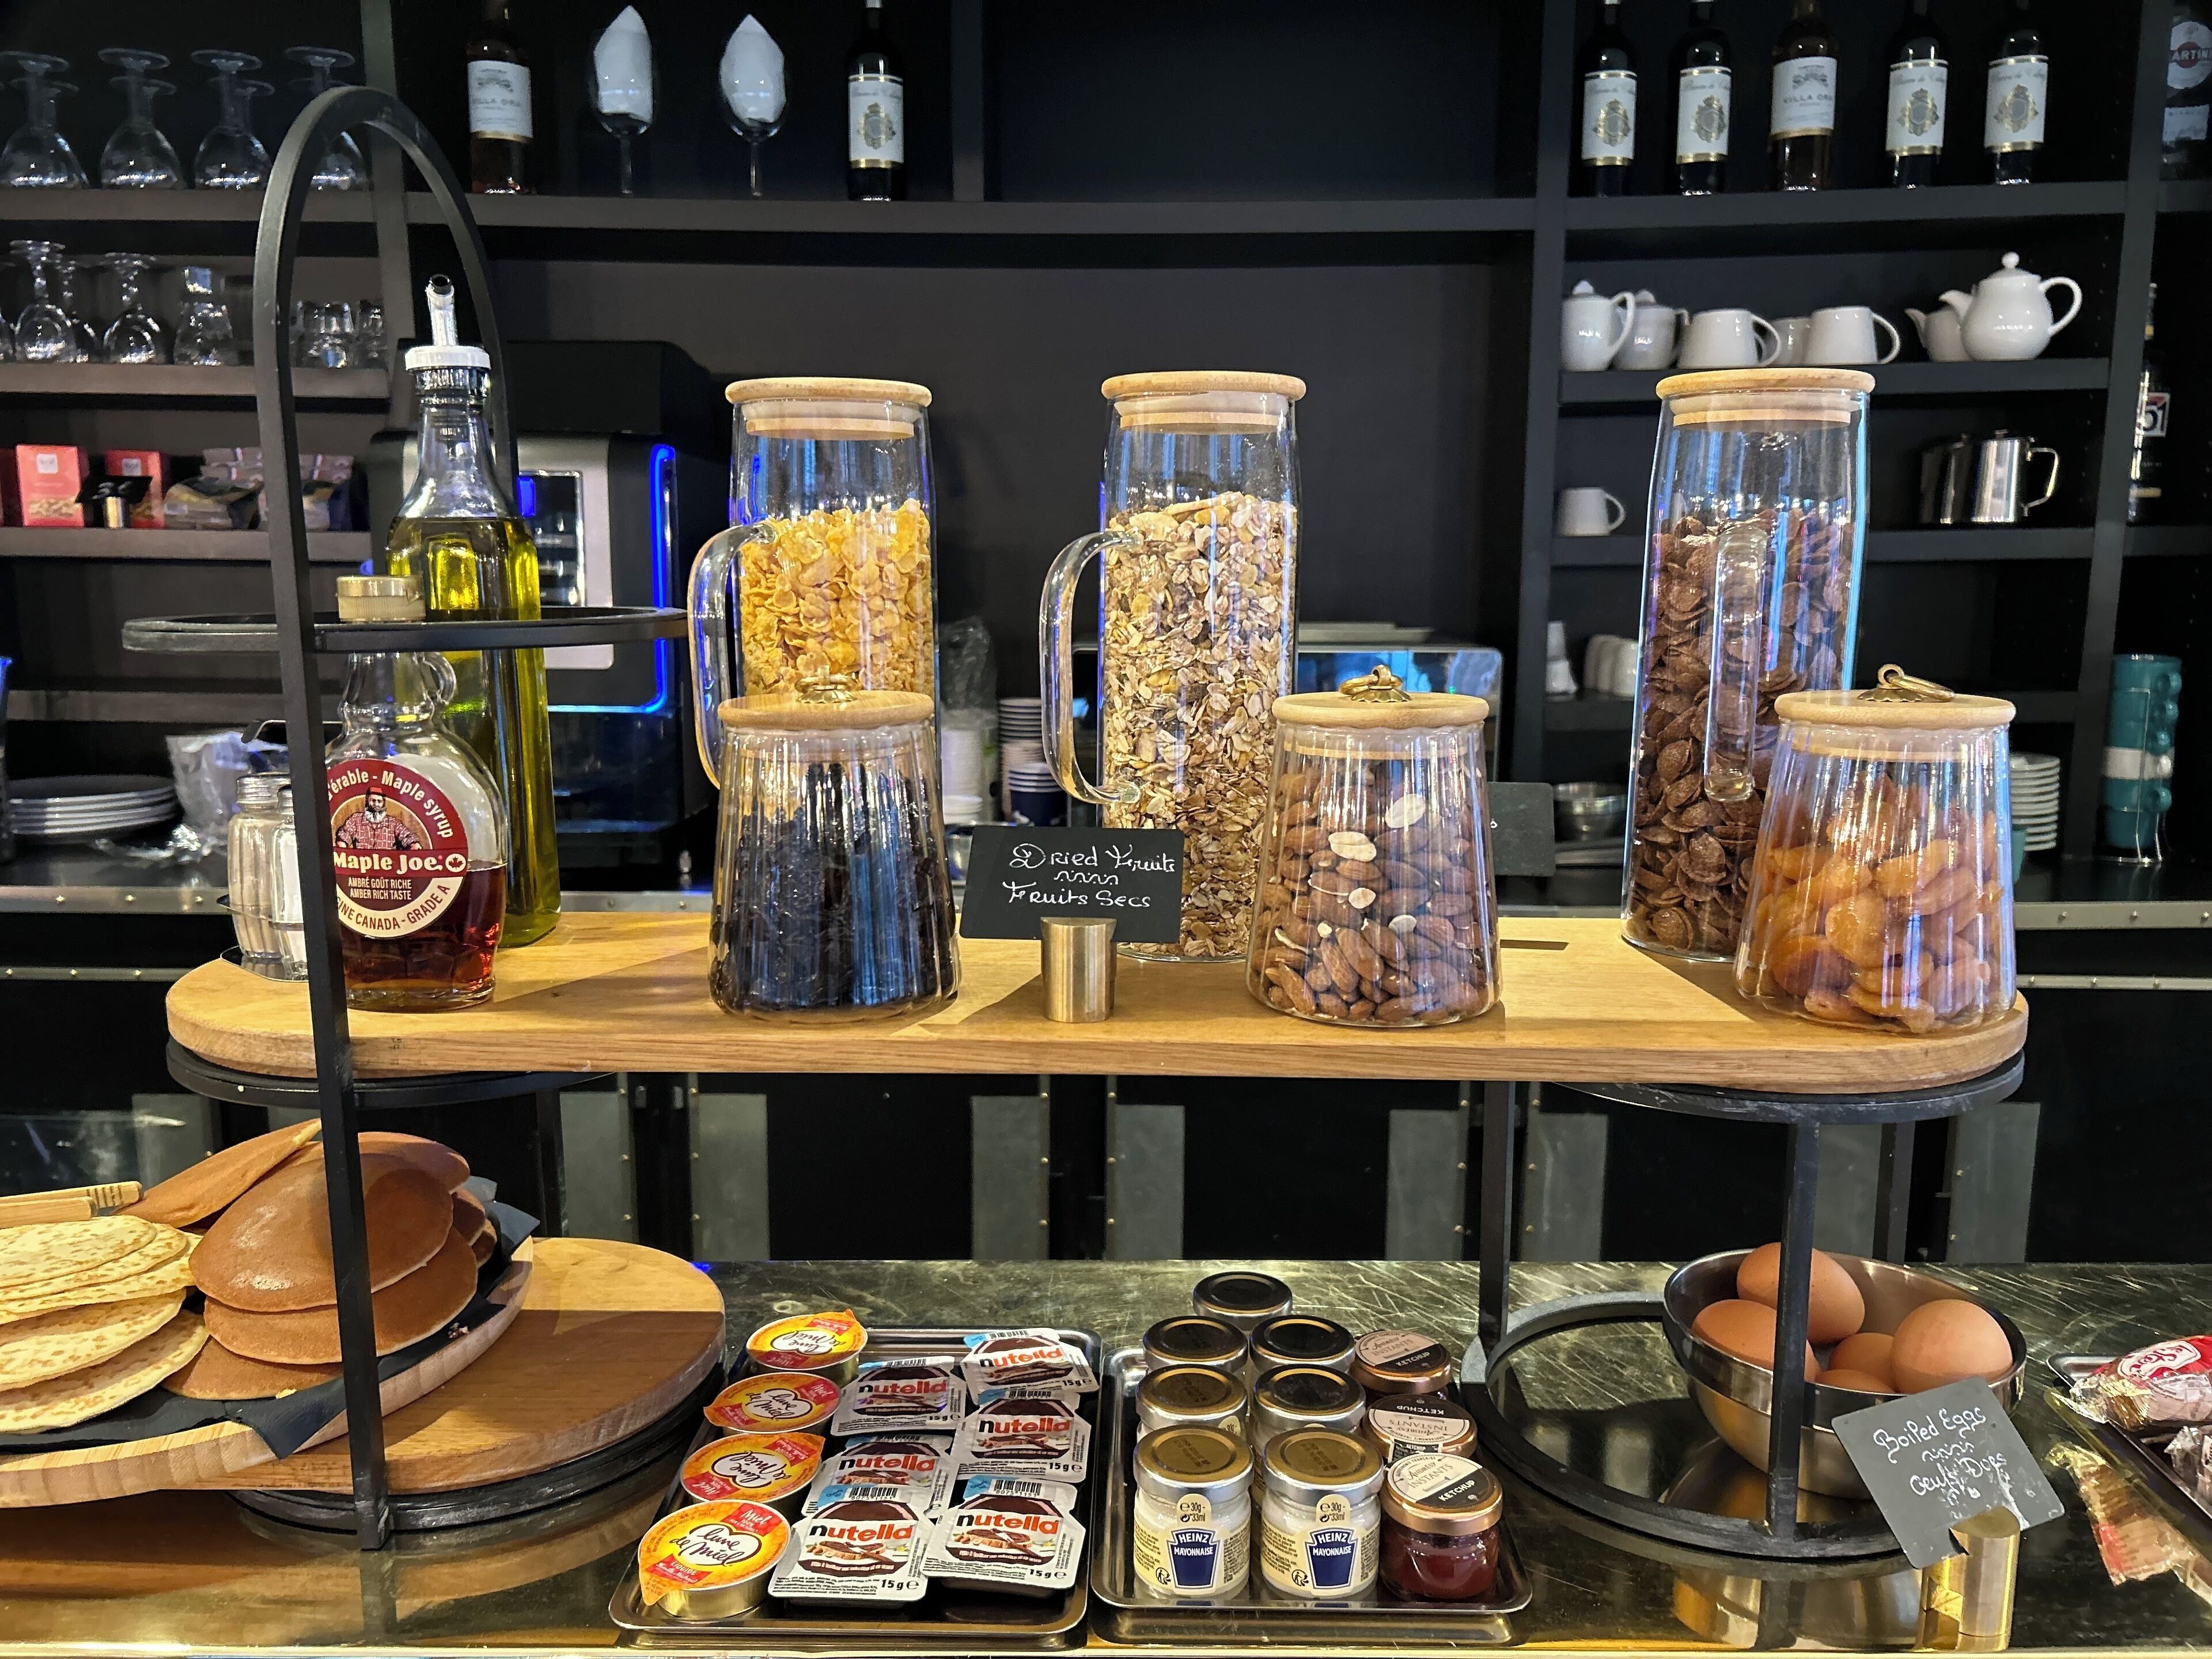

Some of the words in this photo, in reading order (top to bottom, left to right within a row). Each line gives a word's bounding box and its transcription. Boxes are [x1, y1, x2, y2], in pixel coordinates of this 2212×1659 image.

[381, 770, 425, 801] Maple
[423, 798, 454, 838] syrup
[334, 851, 393, 873] Maple
[349, 876, 370, 888] AMBRÉ
[371, 876, 389, 888] GOÛT
[390, 878, 412, 889] RICHE
[350, 889, 372, 899] AMBER
[373, 889, 389, 900] RICH
[389, 890, 412, 900] TASTE
[1095, 889, 1152, 908] Secs
[355, 912, 400, 930] CANADA
[407, 893, 443, 924] GRADE
[437, 884, 451, 895] A
[979, 1347, 1063, 1368] nutella
[1396, 1351, 1430, 1367] KETCHUP
[858, 1380, 947, 1394] nutella
[1396, 1406, 1444, 1415] KETCHUP
[978, 1418, 1071, 1434] nutella
[1874, 1415, 1938, 1464] Boiled
[1939, 1406, 1987, 1440] Eggs
[839, 1454, 935, 1472] nutella
[1049, 1462, 1061, 1470] 15
[1409, 1463, 1453, 1488] INSTANTS
[1438, 1479, 1476, 1502] KETCHUP
[1191, 1502, 1202, 1513] 30g
[1331, 1502, 1342, 1513] 30g
[741, 1509, 772, 1526] Miel
[956, 1513, 1059, 1535] nutella
[1192, 1513, 1206, 1522] 33ml
[809, 1524, 913, 1542] nutella
[1178, 1533, 1210, 1544] HEINZ
[1317, 1532, 1349, 1544] HEINZ
[669, 1536, 690, 1550] de
[1173, 1546, 1214, 1556] MAYONNAISE
[1312, 1546, 1352, 1556] MAYONNAISE
[1029, 1569, 1042, 1577] 15
[881, 1579, 895, 1588] 15
[897, 1581, 904, 1591] g
